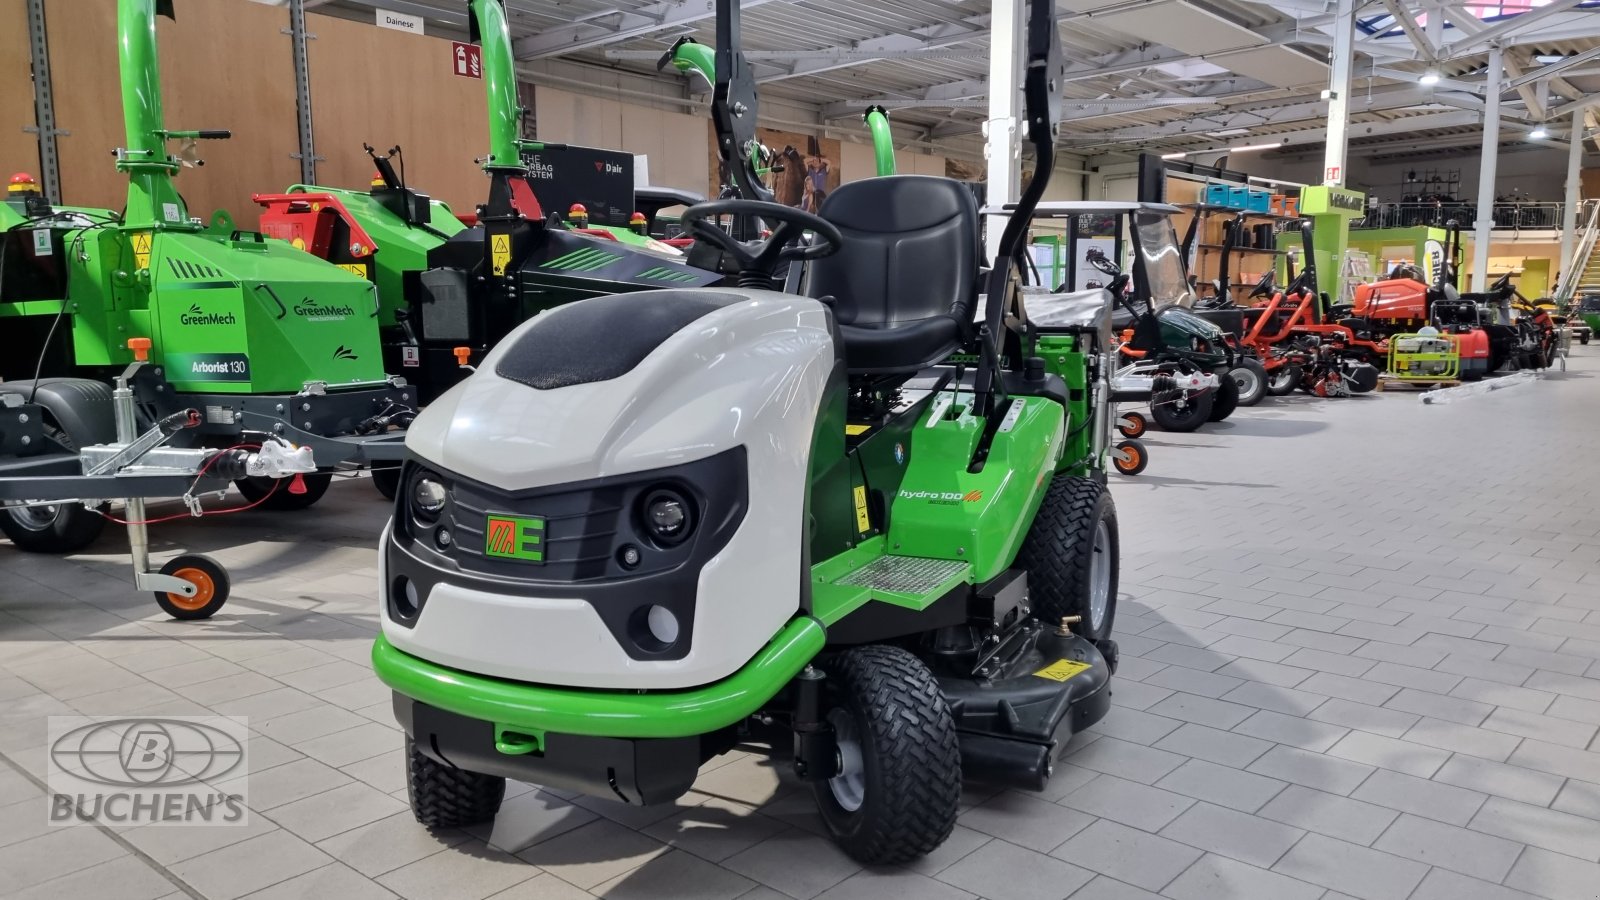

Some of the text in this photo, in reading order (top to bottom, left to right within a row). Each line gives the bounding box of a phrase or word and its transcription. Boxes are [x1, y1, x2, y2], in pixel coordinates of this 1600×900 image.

[386, 16, 414, 29] Dainese
[521, 153, 542, 164] THE
[527, 163, 553, 172] IRBAG
[294, 304, 355, 317] GreenMech
[180, 311, 236, 326] GreenMech
[191, 360, 246, 374] Arborist 130
[900, 489, 964, 500] hydro 100
